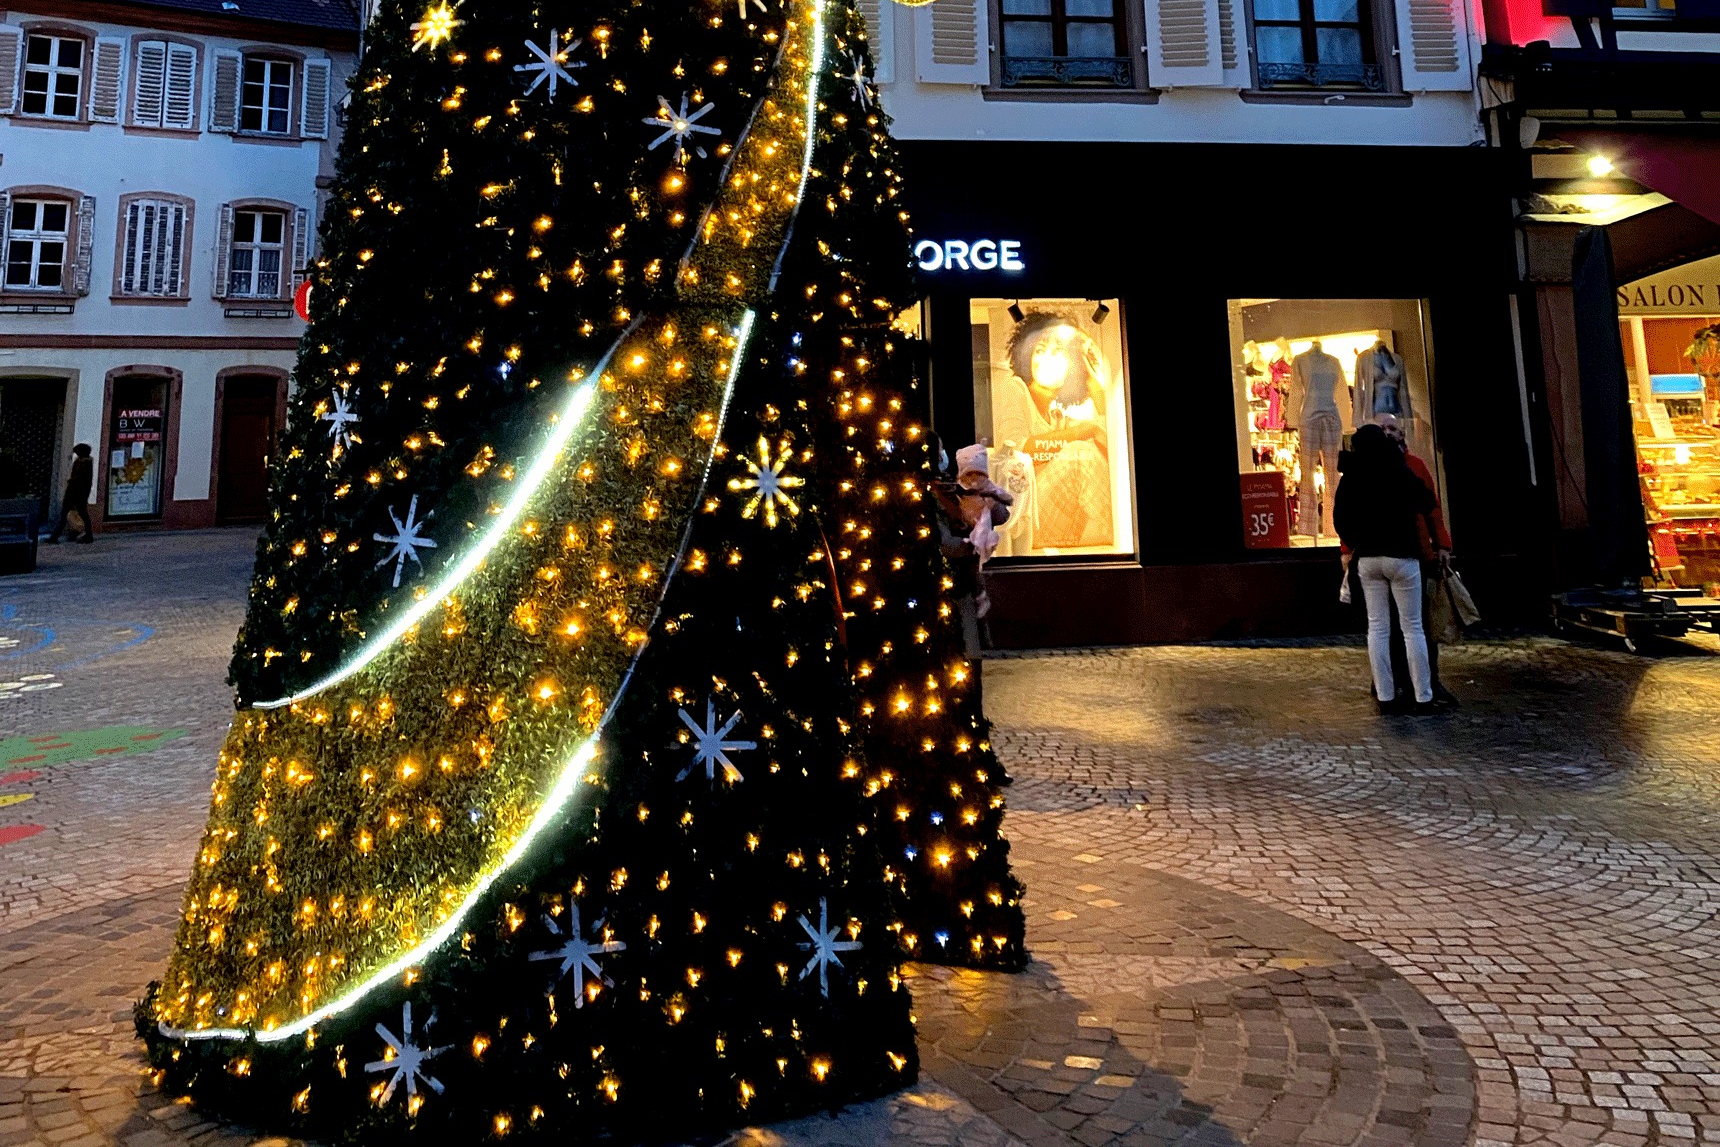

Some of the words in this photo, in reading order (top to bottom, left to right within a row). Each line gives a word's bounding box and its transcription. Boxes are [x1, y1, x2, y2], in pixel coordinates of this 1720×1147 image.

[914, 239, 1023, 271] ORGE
[1616, 284, 1705, 307] SALON
[129, 409, 161, 418] VENDRE
[133, 418, 146, 428] W
[1035, 439, 1069, 450] PYJAMA
[1251, 512, 1275, 536] 35€
